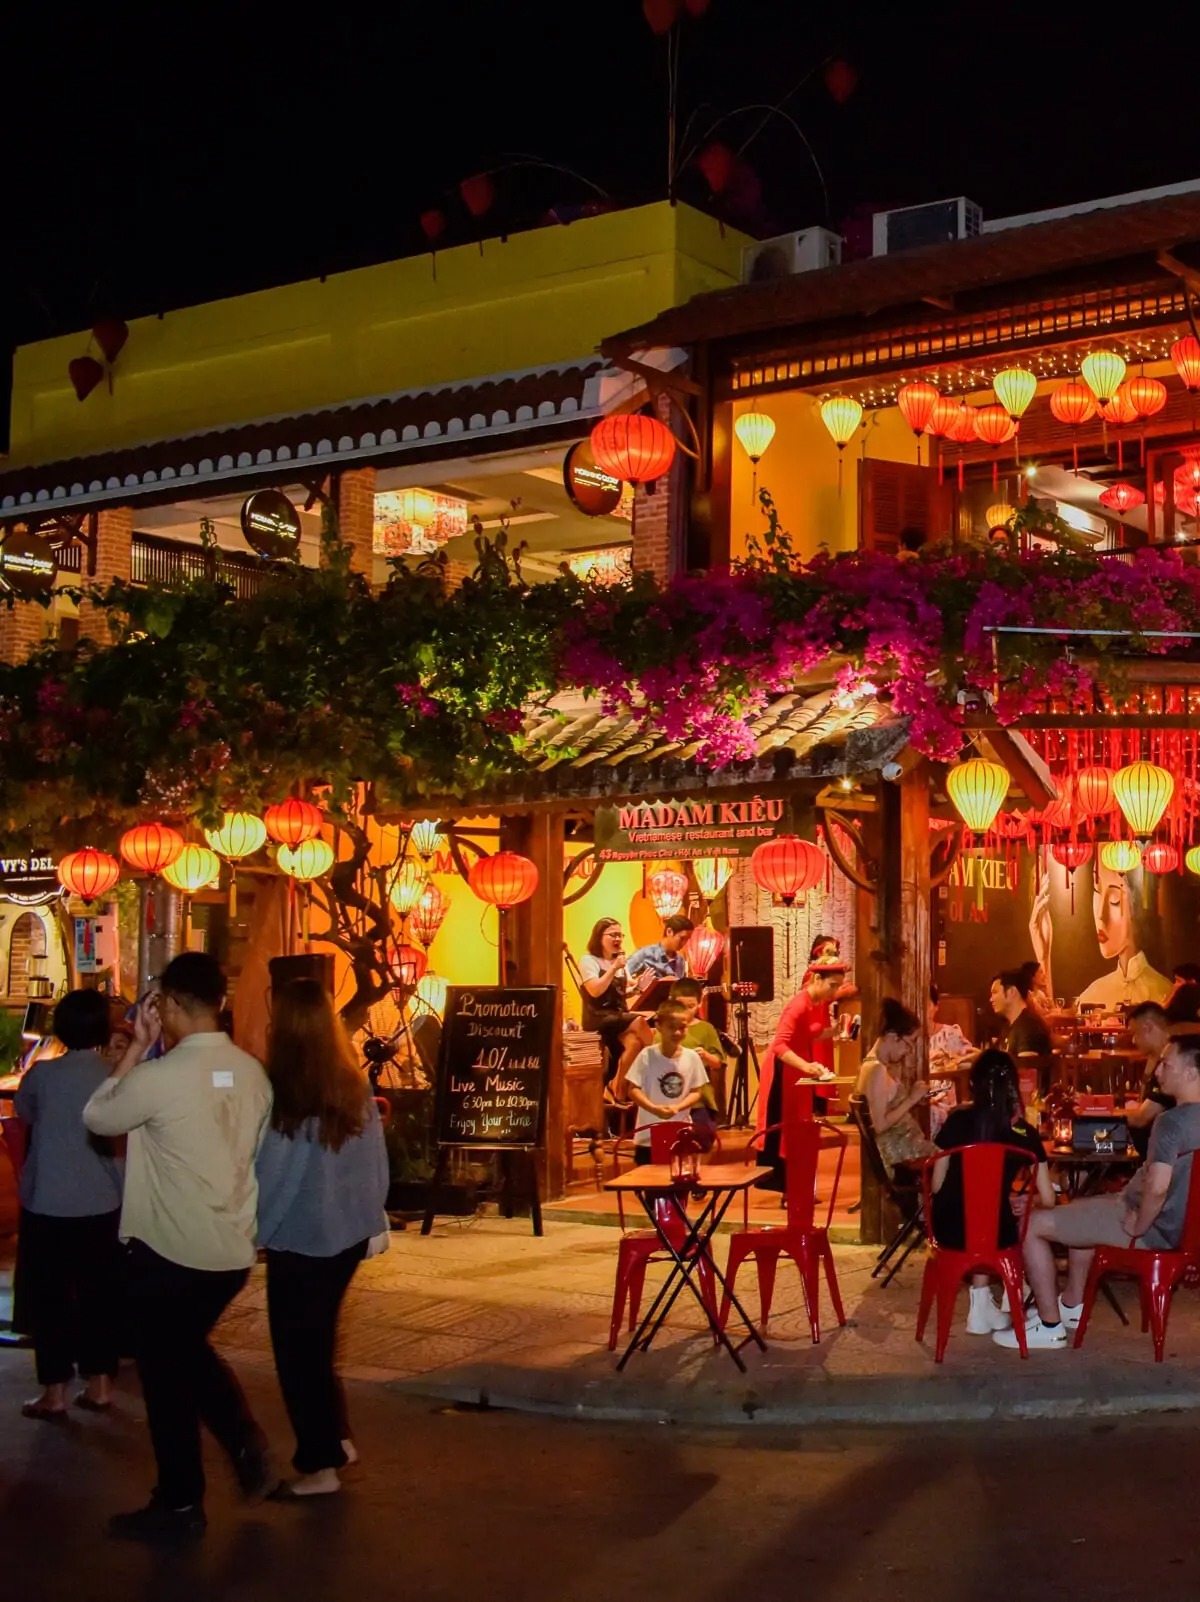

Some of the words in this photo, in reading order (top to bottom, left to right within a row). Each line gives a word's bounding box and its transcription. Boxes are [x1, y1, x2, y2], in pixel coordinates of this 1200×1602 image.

[619, 803, 714, 830] MADAM
[628, 830, 682, 843] Vietnamese
[685, 828, 735, 841] restaurant
[736, 827, 755, 838] and
[756, 826, 775, 837] bar
[456, 992, 539, 1018] Promotion
[465, 1020, 525, 1039] Discount
[471, 1046, 509, 1071] 10%
[451, 1075, 476, 1092] Live
[485, 1073, 525, 1092] Music
[495, 1095, 506, 1108] to
[450, 1113, 476, 1136] Enjoy
[505, 1110, 532, 1128] time
